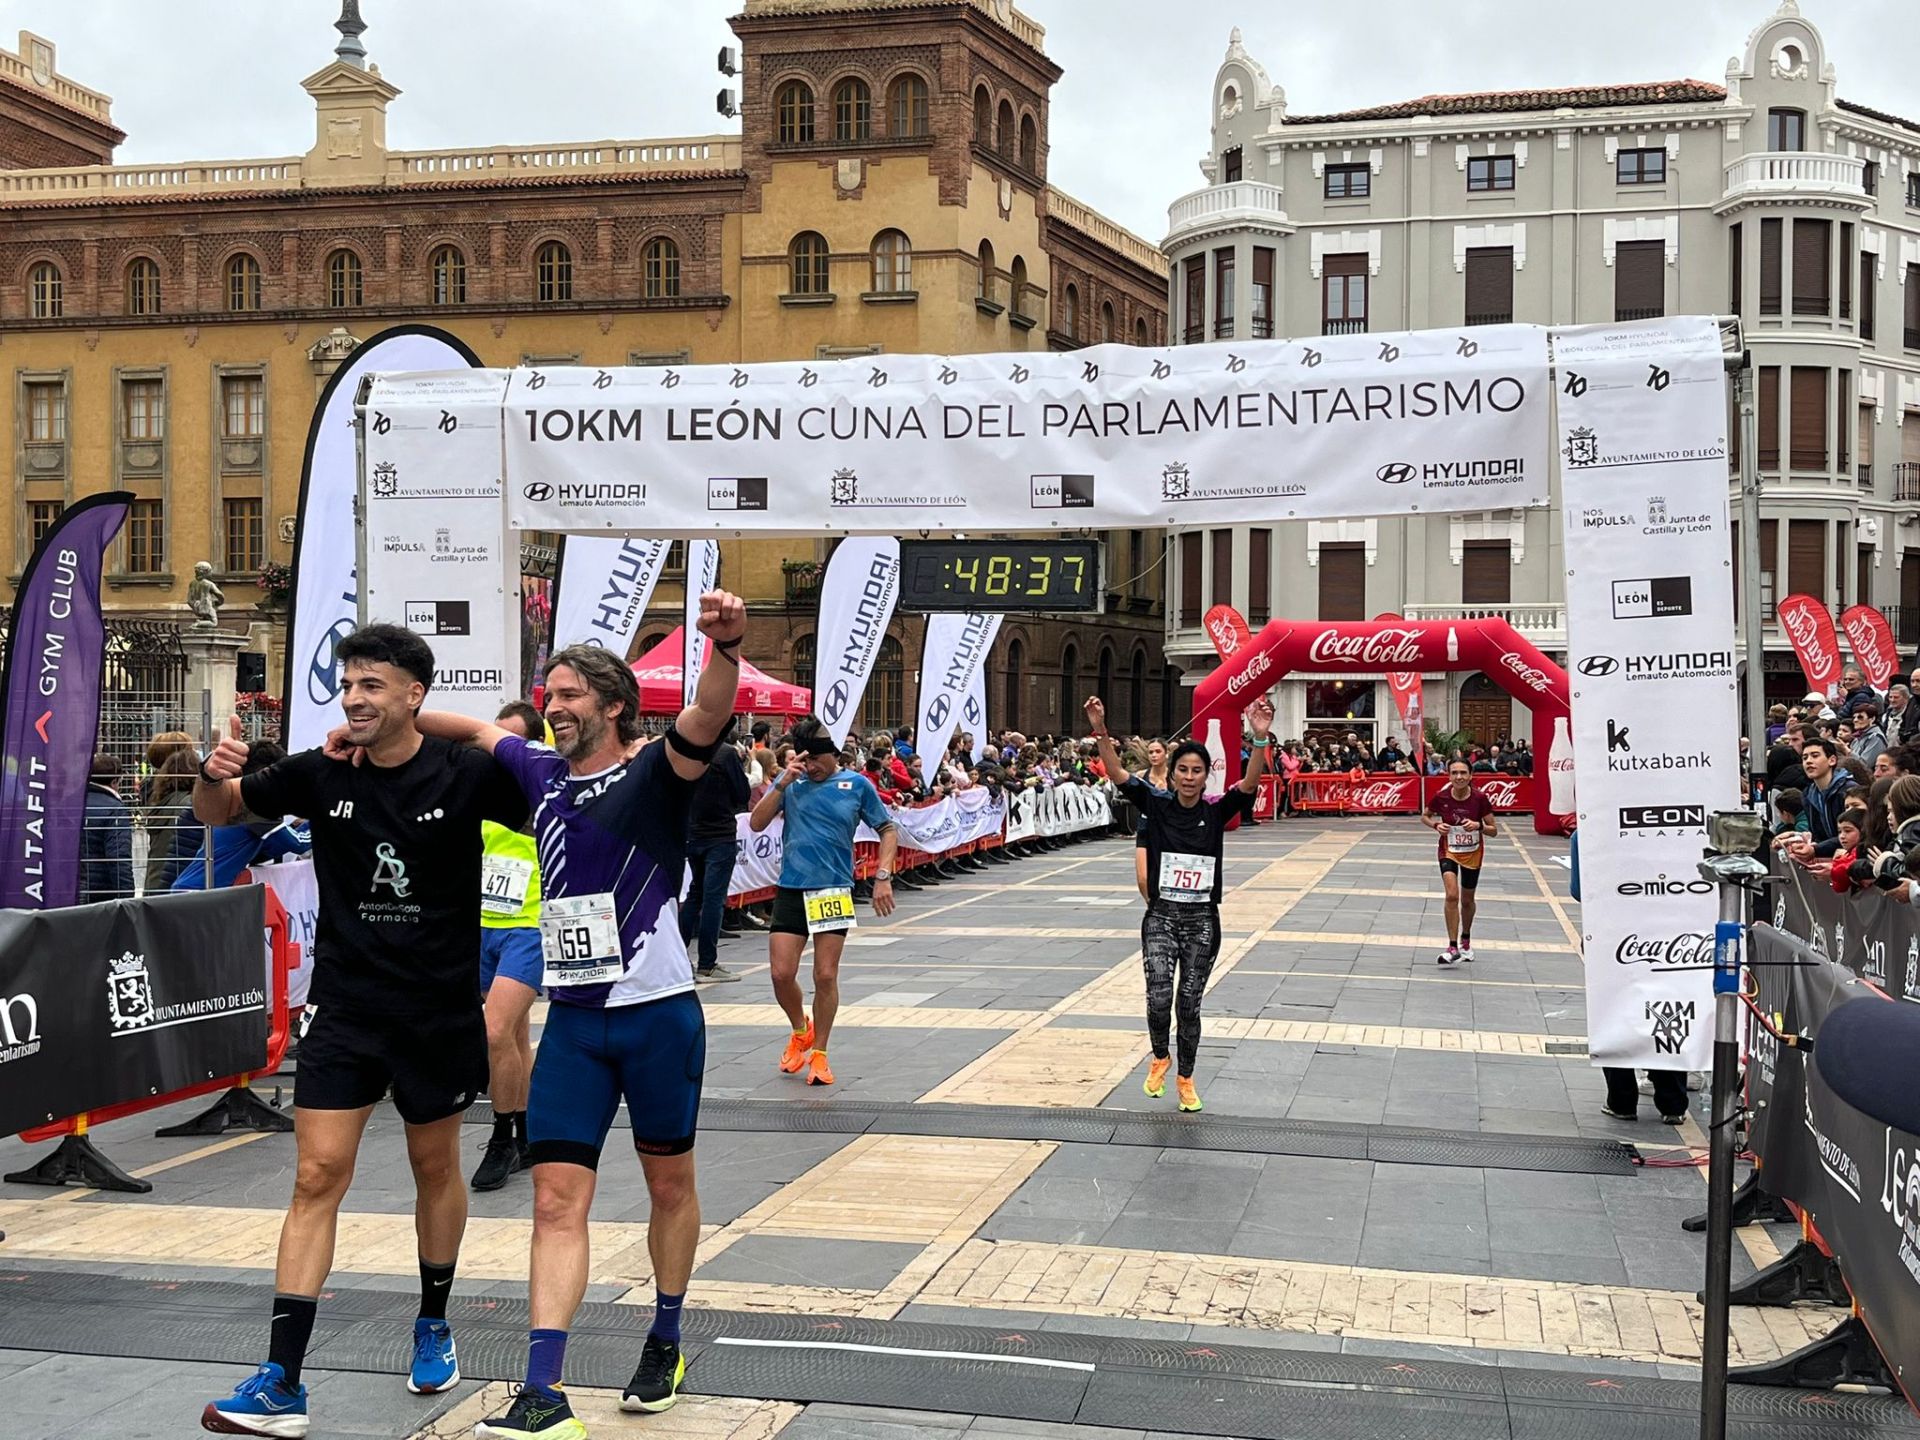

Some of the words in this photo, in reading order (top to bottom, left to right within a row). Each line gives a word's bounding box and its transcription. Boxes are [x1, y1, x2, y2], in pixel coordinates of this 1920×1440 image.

[525, 408, 642, 441] 10KM
[667, 399, 781, 441] LEÓN
[797, 406, 927, 440] CUNA
[943, 404, 1025, 439] DEL
[1042, 376, 1525, 438] PARLAMENTARISMO
[1601, 450, 1680, 464] AYUNTAMIENTO
[1682, 449, 1695, 457] DE
[1697, 446, 1725, 456] LEÓN
[1423, 458, 1524, 480] HYUNDAI
[400, 488, 462, 496] AYUNTAMIENTO
[478, 486, 500, 495] LEÓN
[1034, 484, 1060, 496] LEÓN
[1192, 486, 1265, 497] AYUNTAMIENTO
[1267, 485, 1280, 493] DE
[1282, 483, 1307, 492] LEÓN
[1423, 480, 1466, 488] Lemauto
[1467, 476, 1524, 486] Automoción
[558, 484, 646, 499] HYUNDAI
[712, 487, 735, 498] LEÓN
[859, 496, 926, 504] AYUNTAMIENTO
[942, 494, 966, 503] LEÓN
[559, 499, 593, 507] Lemauto
[595, 499, 646, 507] Automoción
[1669, 516, 1696, 524] Junta
[1698, 514, 1711, 522] de
[1643, 526, 1677, 535] Castilla
[1678, 527, 1686, 535] y
[1687, 524, 1712, 532] León
[430, 554, 459, 562] Castilla
[467, 554, 488, 562] León
[452, 546, 475, 554] Junta
[49, 548, 78, 620] CLUB
[591, 538, 652, 632] HYUN
[615, 571, 651, 637] Lemauto
[1617, 591, 1649, 604] LEÓN
[409, 611, 434, 622] LEÓN
[839, 552, 893, 675] HYUNDAI
[974, 613, 996, 653] Automo
[855, 628, 878, 678] Lemauto
[942, 613, 986, 690] HYUND
[1310, 629, 1428, 664] Coca-Cola
[39, 634, 65, 697] GYM
[1626, 652, 1732, 672] HYUNDAI
[432, 669, 502, 683] YUNDAI
[1228, 650, 1273, 695] Coca-Cola
[1500, 652, 1557, 694] Coca-Cola
[1626, 671, 1669, 681] Lemauto
[1672, 668, 1733, 679] Automoción
[451, 683, 503, 692] Automoción
[1608, 751, 1712, 772] kutxabank
[329, 800, 354, 819] JA
[1622, 807, 1702, 825] LEON
[24, 756, 48, 902] ALTAFIT
[1620, 828, 1706, 838] PLAZA
[486, 874, 511, 896] 471
[1174, 870, 1202, 888] 757
[1617, 873, 1714, 896] emico
[819, 900, 842, 918] 139
[557, 926, 593, 960] 159
[1615, 932, 1716, 964] Coca-Cola
[228, 993, 240, 1010] DE
[242, 987, 264, 1006] LEÓN
